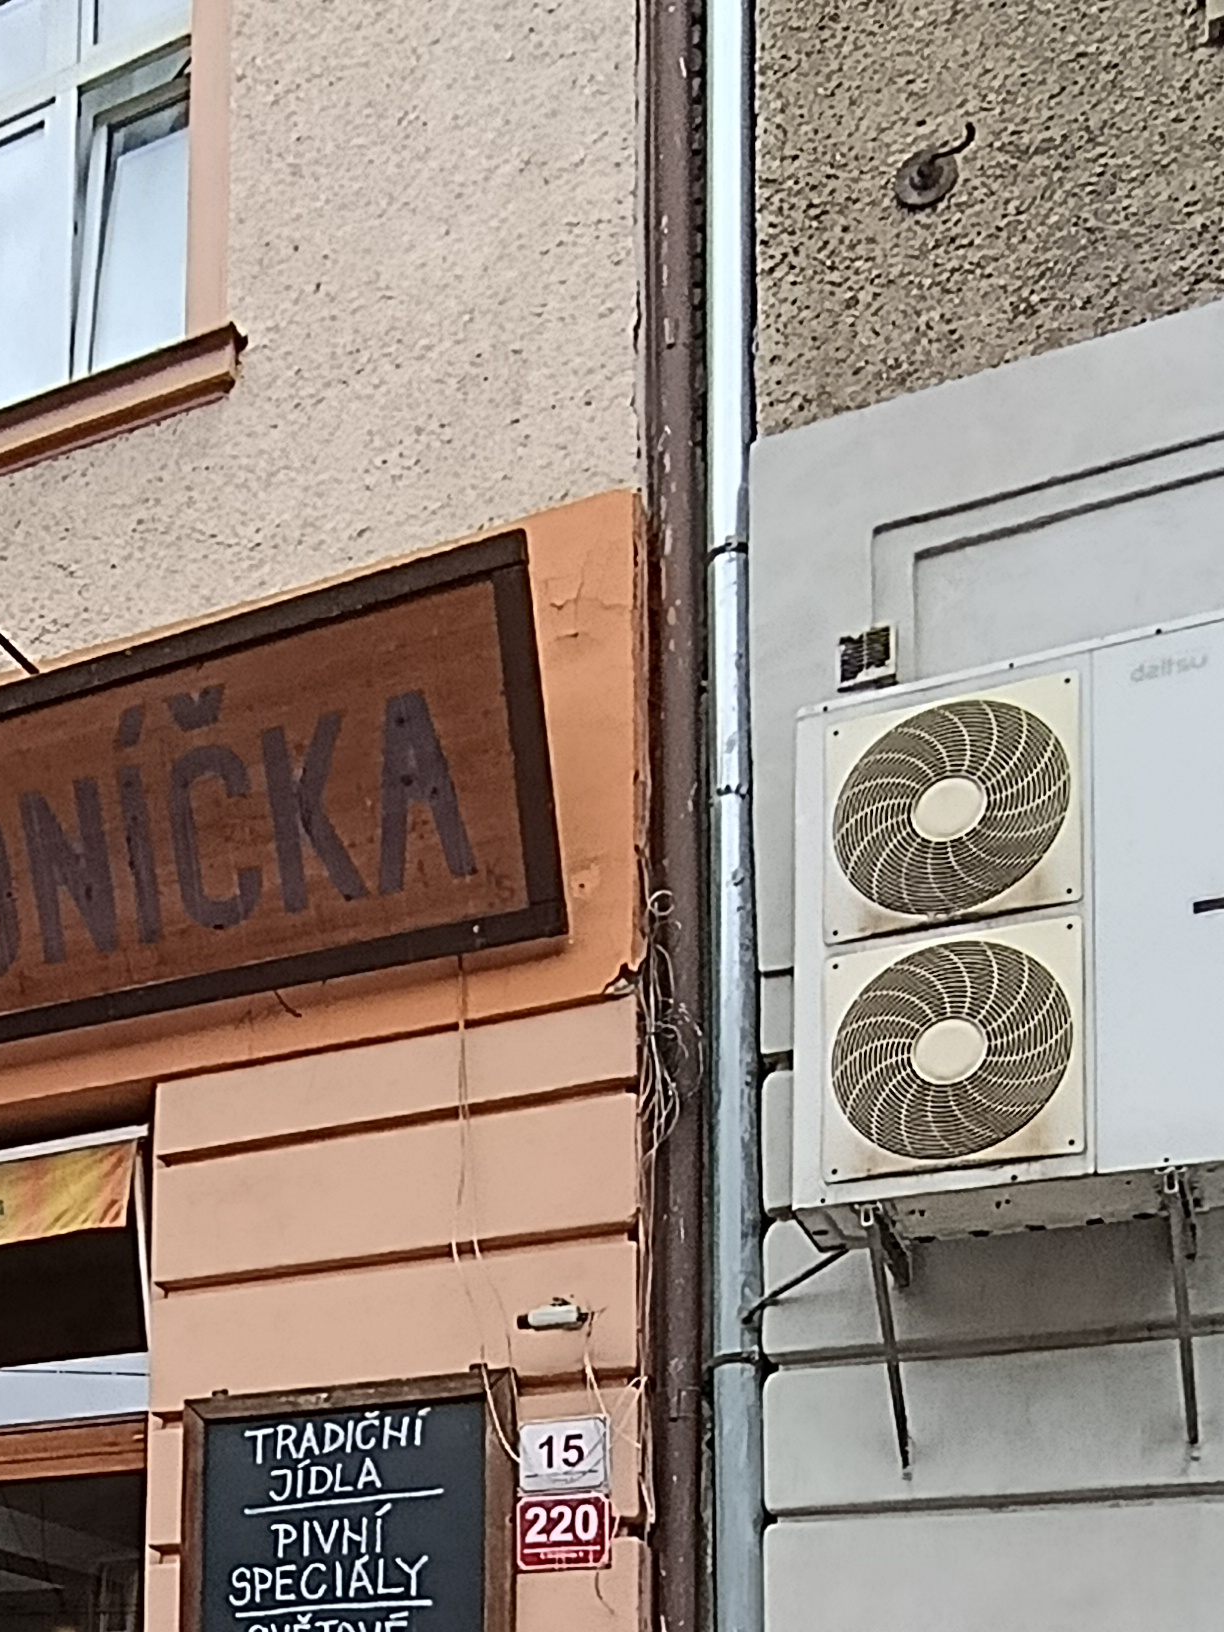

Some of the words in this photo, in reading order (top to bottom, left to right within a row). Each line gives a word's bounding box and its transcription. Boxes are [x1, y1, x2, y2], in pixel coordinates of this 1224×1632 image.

[243, 1407, 432, 1464] TRADIČNÍ
[538, 1433, 585, 1469] 15
[269, 1457, 382, 1501] JÍDLA
[270, 1502, 392, 1559] PIVNÍ
[524, 1503, 599, 1543] 220
[229, 1554, 429, 1606] SPECIÁLY
